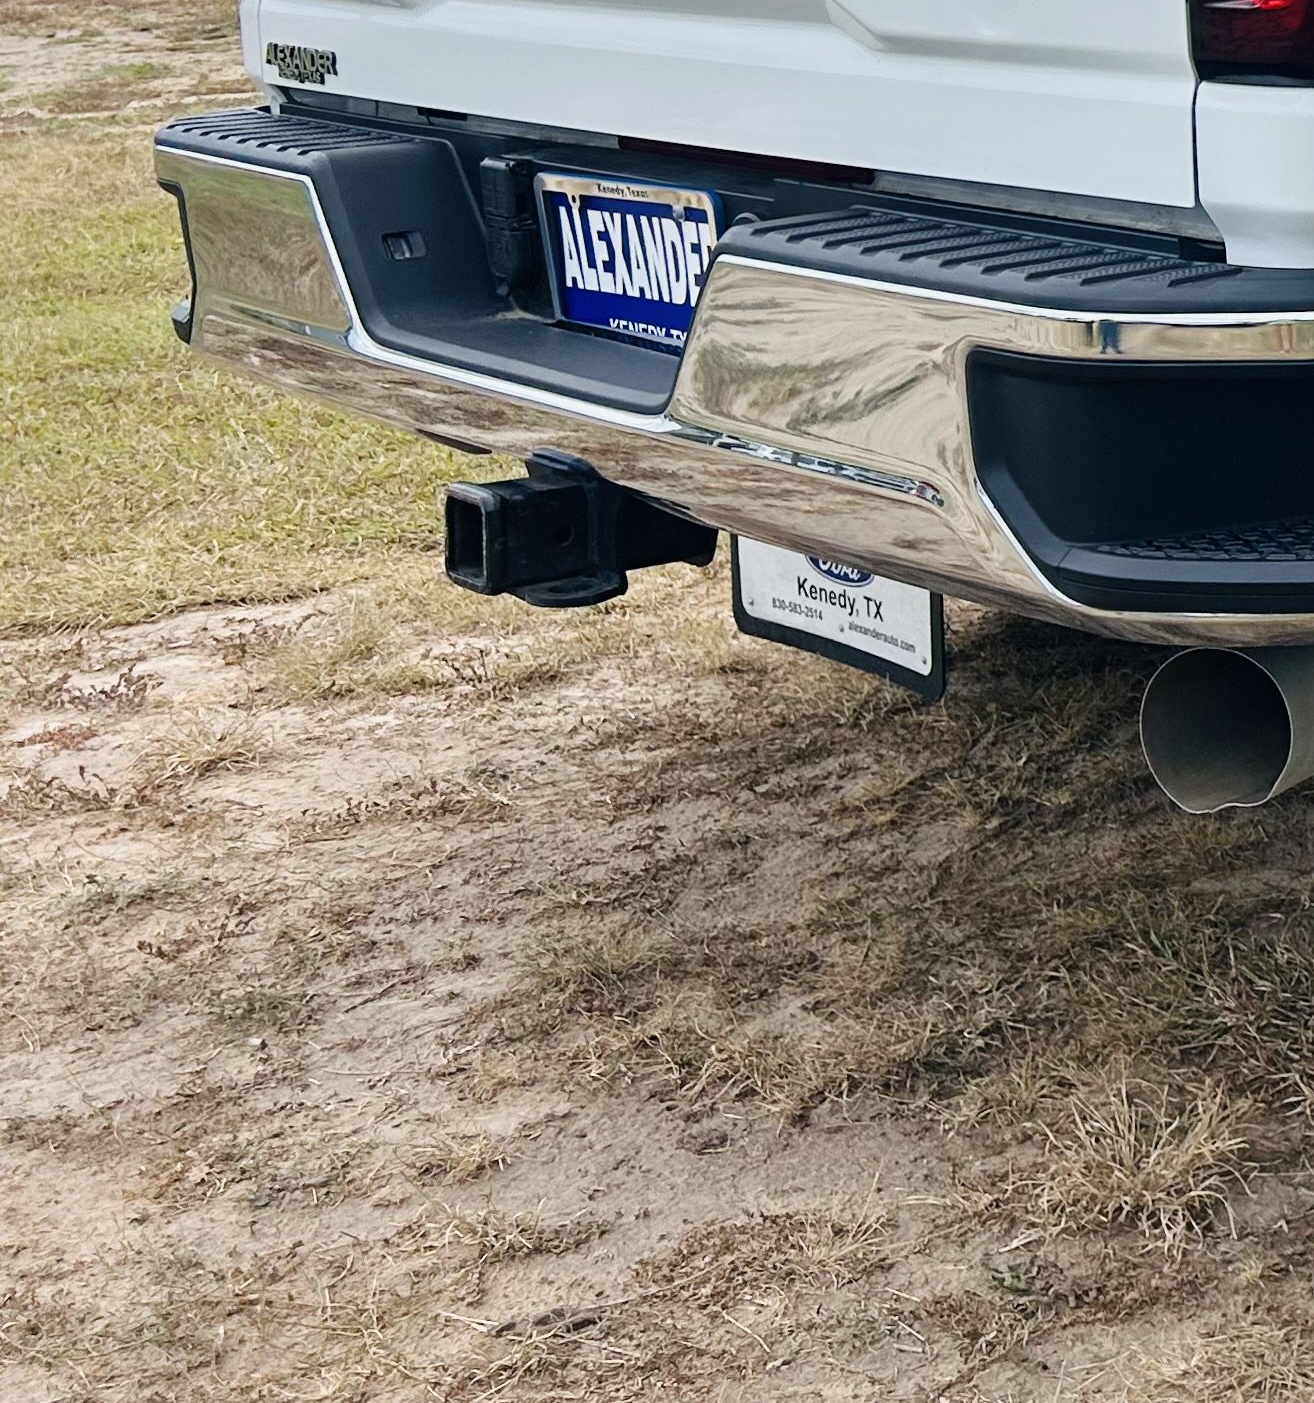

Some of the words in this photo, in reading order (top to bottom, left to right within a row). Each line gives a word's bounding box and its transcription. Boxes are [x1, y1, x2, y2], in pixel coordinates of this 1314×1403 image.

[265, 42, 338, 77] ALEXANDER
[796, 576, 860, 617] Kenedy,
[862, 595, 884, 623] TX
[847, 619, 916, 654] alexanderauto.com
